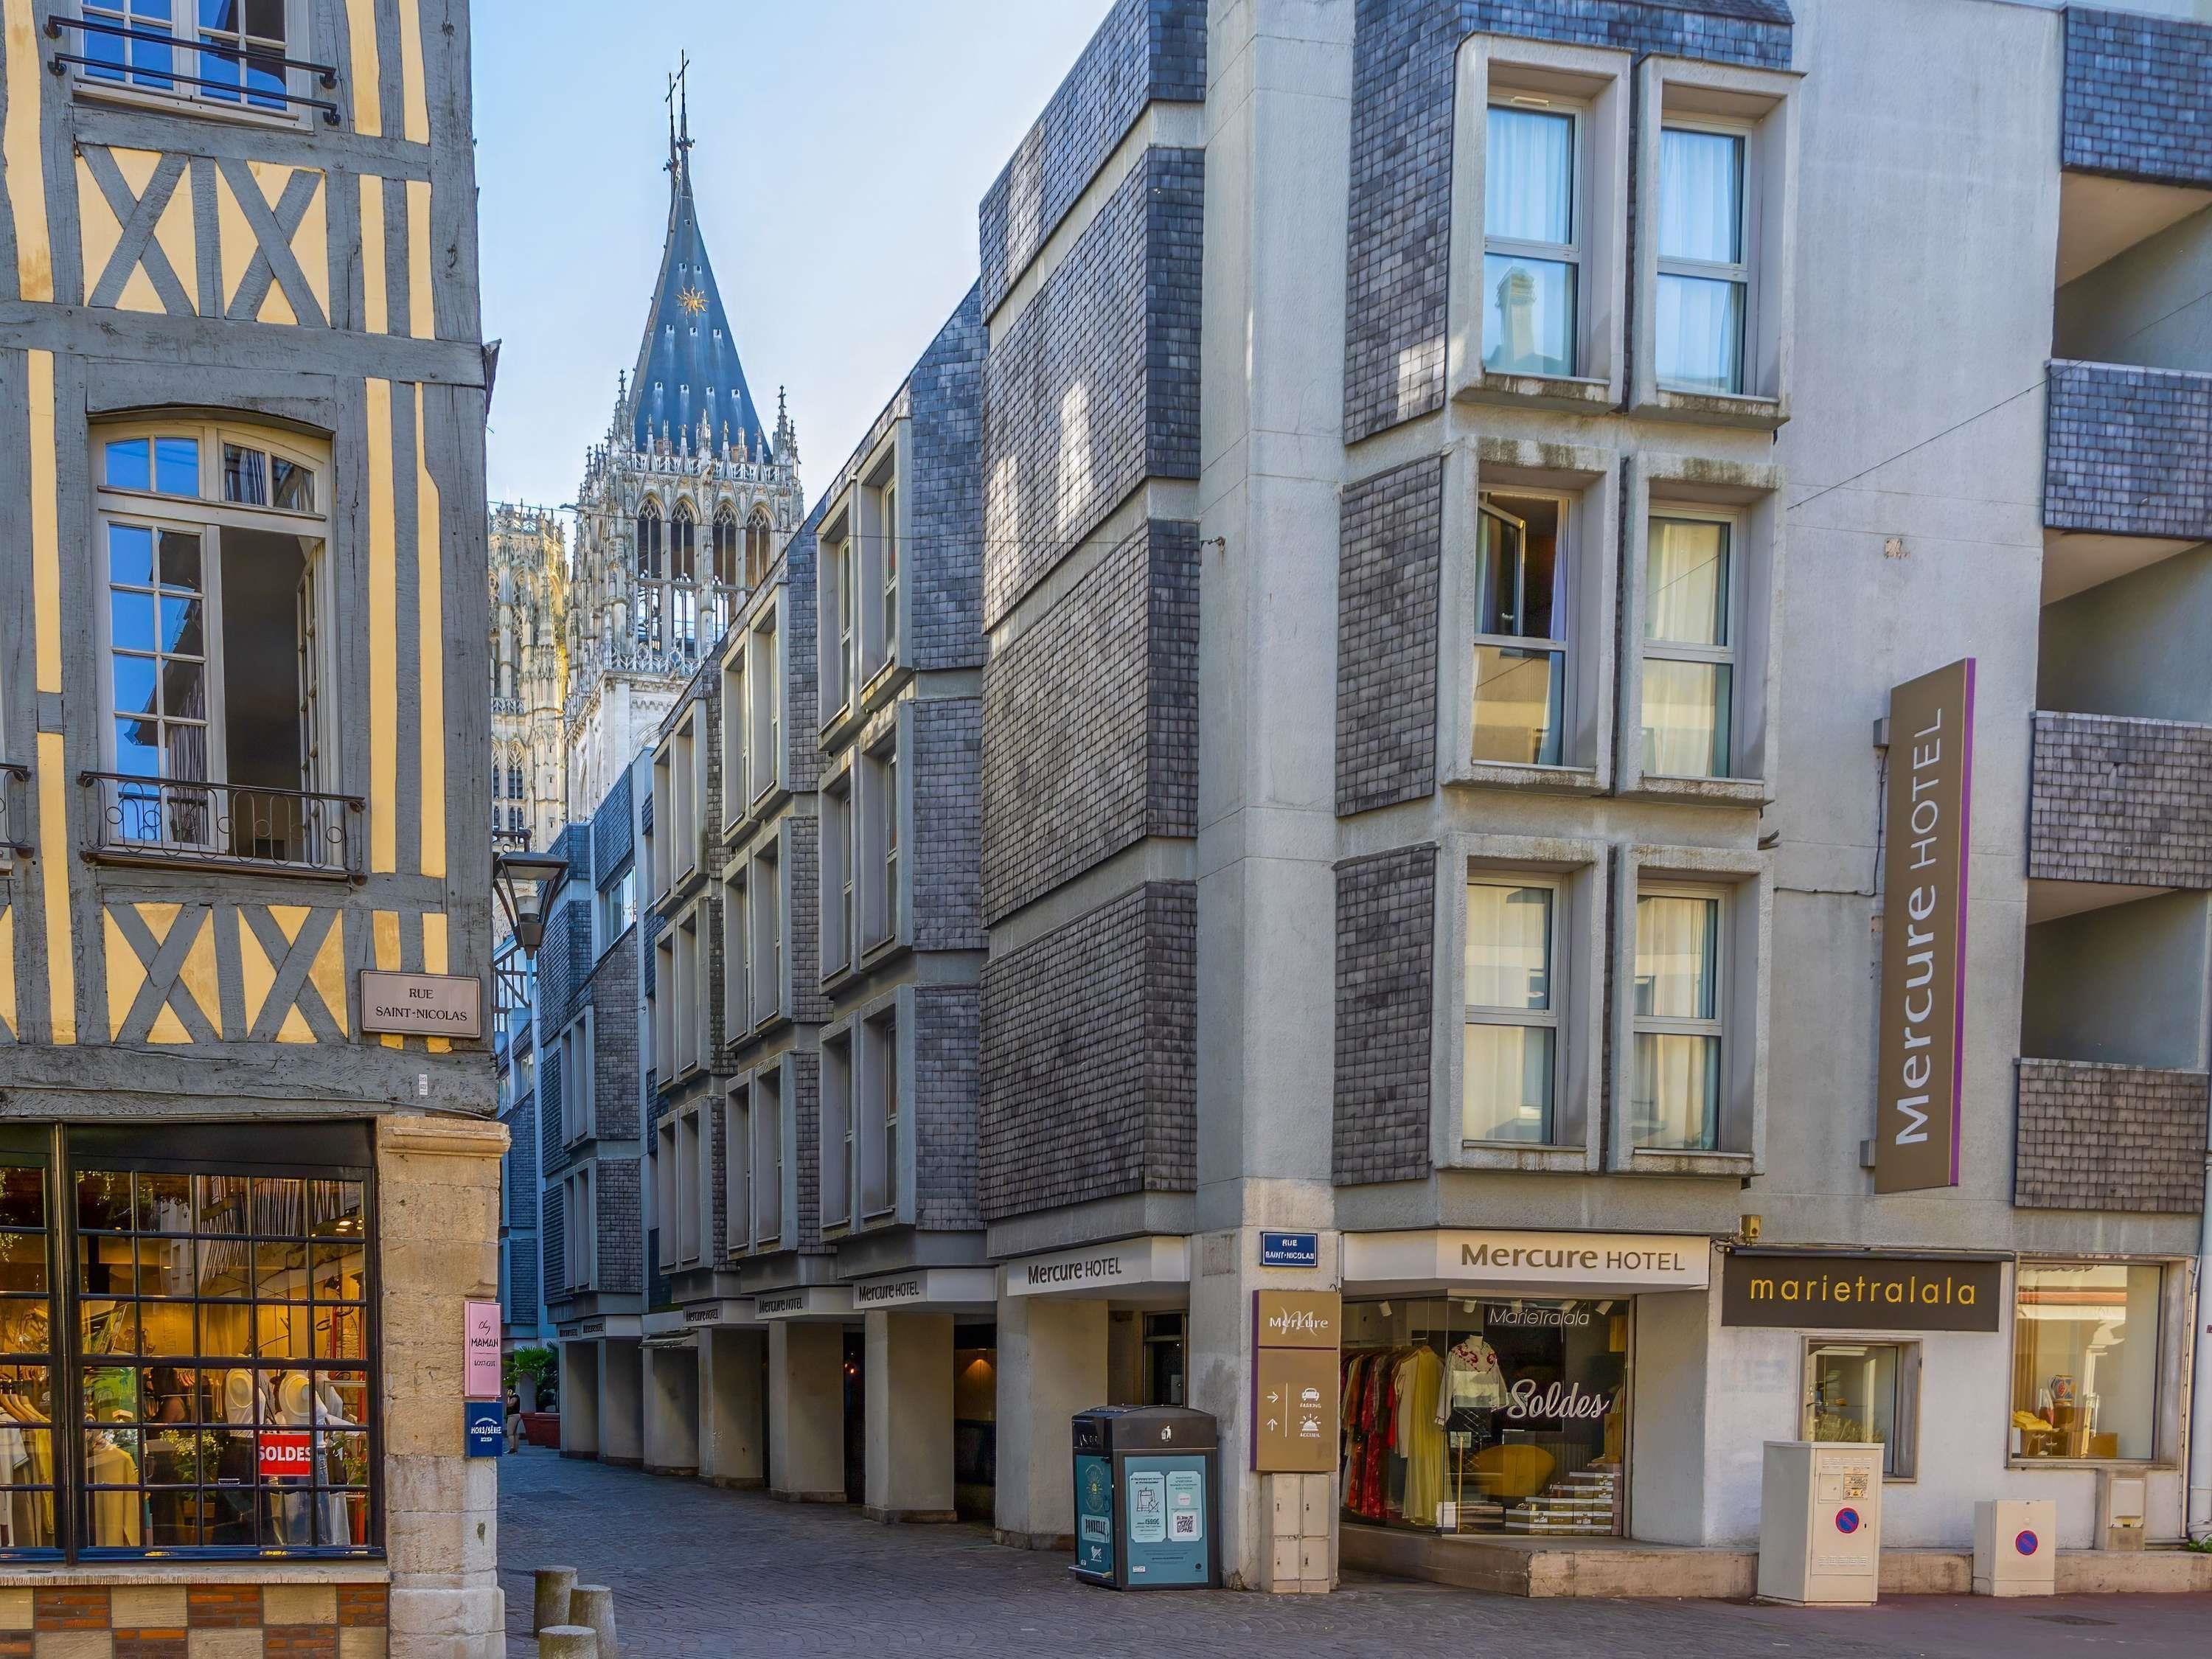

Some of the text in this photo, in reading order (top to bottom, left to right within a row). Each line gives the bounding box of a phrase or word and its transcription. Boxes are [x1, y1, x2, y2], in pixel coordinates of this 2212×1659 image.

[1896, 708, 1942, 1146] Mercure HOTEL
[409, 988, 434, 999] RUE
[375, 1006, 467, 1021] SAINT-NICOLAS
[1281, 1239, 1298, 1247] RUE
[1461, 1243, 1686, 1270] Mercure HOTEL
[1028, 1256, 1122, 1285] Mercure HOTEL
[858, 1281, 920, 1302] Mercure HOTEL
[1750, 1274, 1976, 1304] marietralala
[471, 1338, 498, 1348] MAMAN
[1507, 1378, 1610, 1419] Soldes
